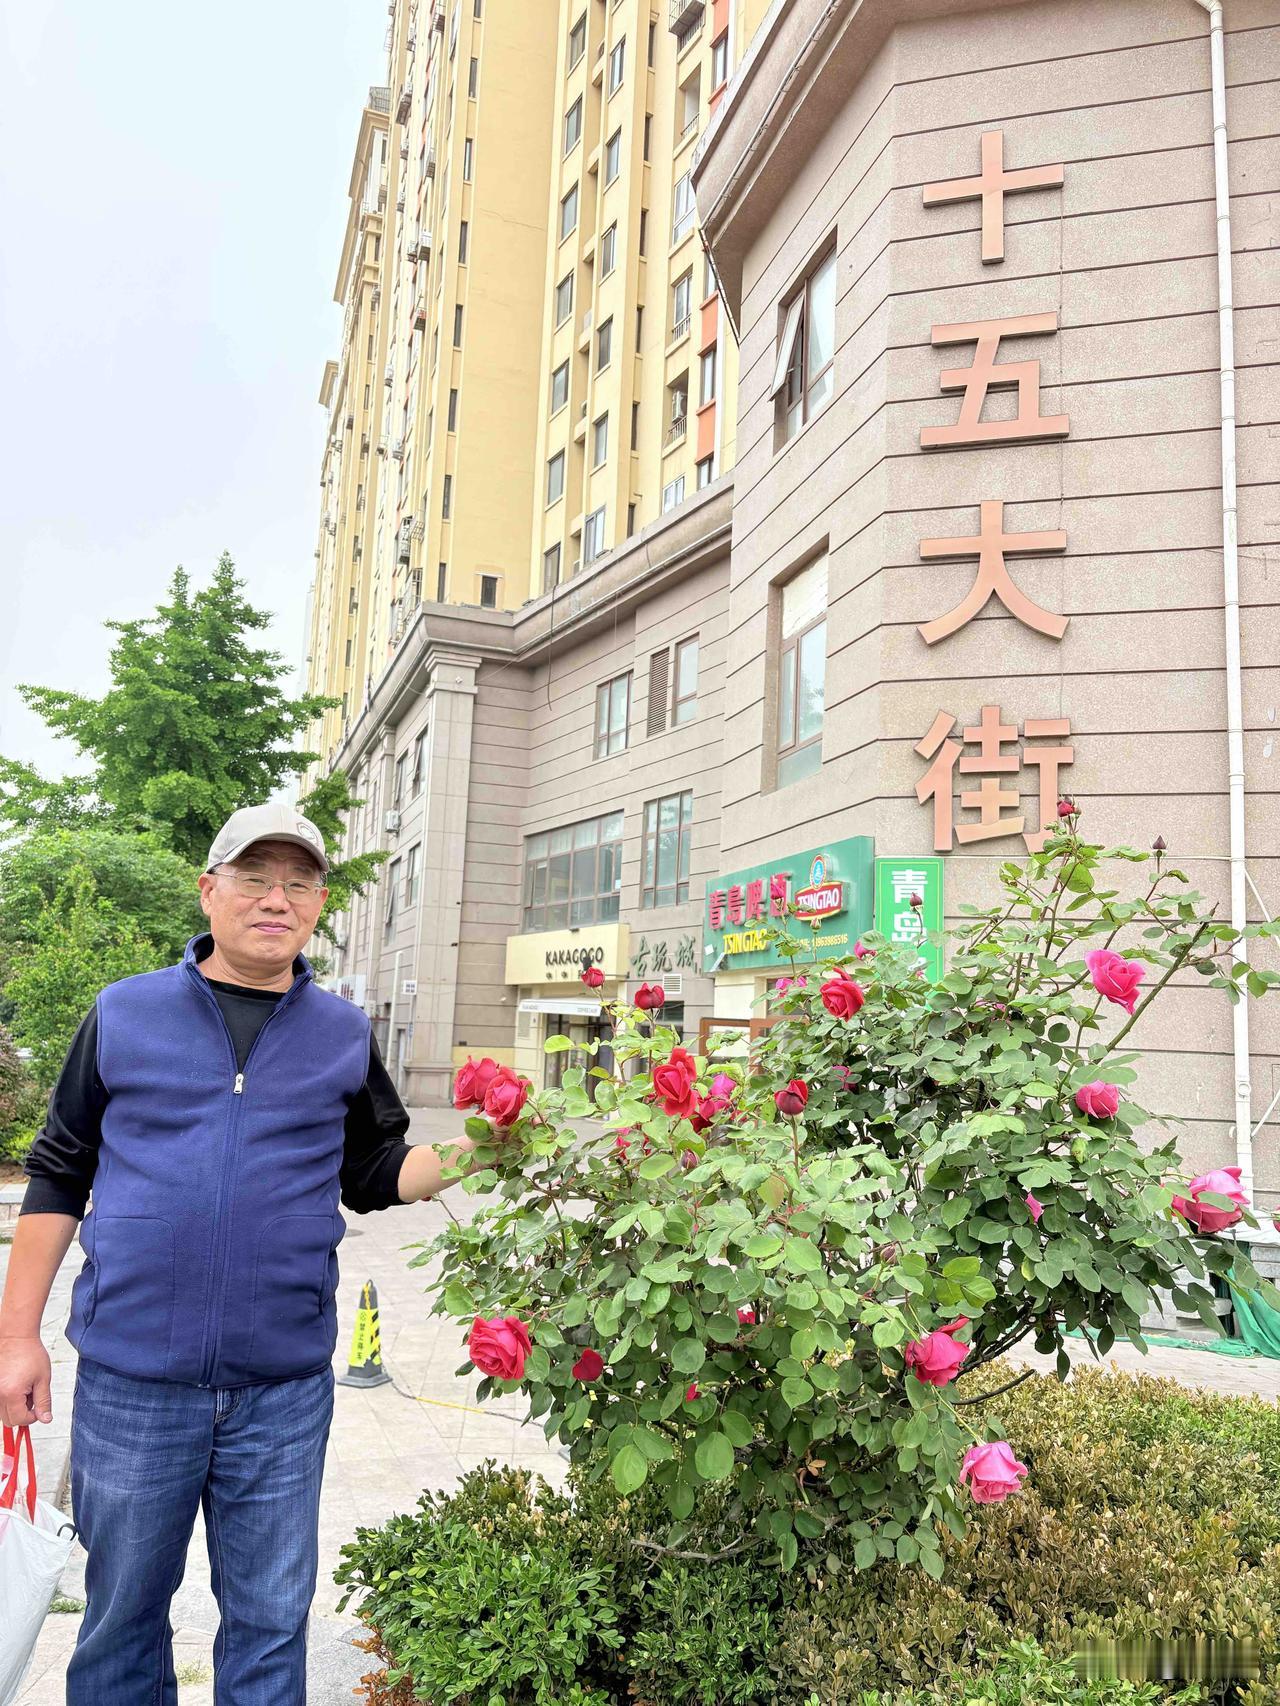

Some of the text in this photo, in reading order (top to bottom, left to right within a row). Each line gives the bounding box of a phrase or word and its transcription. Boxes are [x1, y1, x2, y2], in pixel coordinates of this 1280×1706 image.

[914, 129, 1076, 854] 十五大街
[797, 887, 840, 913] TSINGTAO
[545, 946, 604, 967] KAKAGOGO
